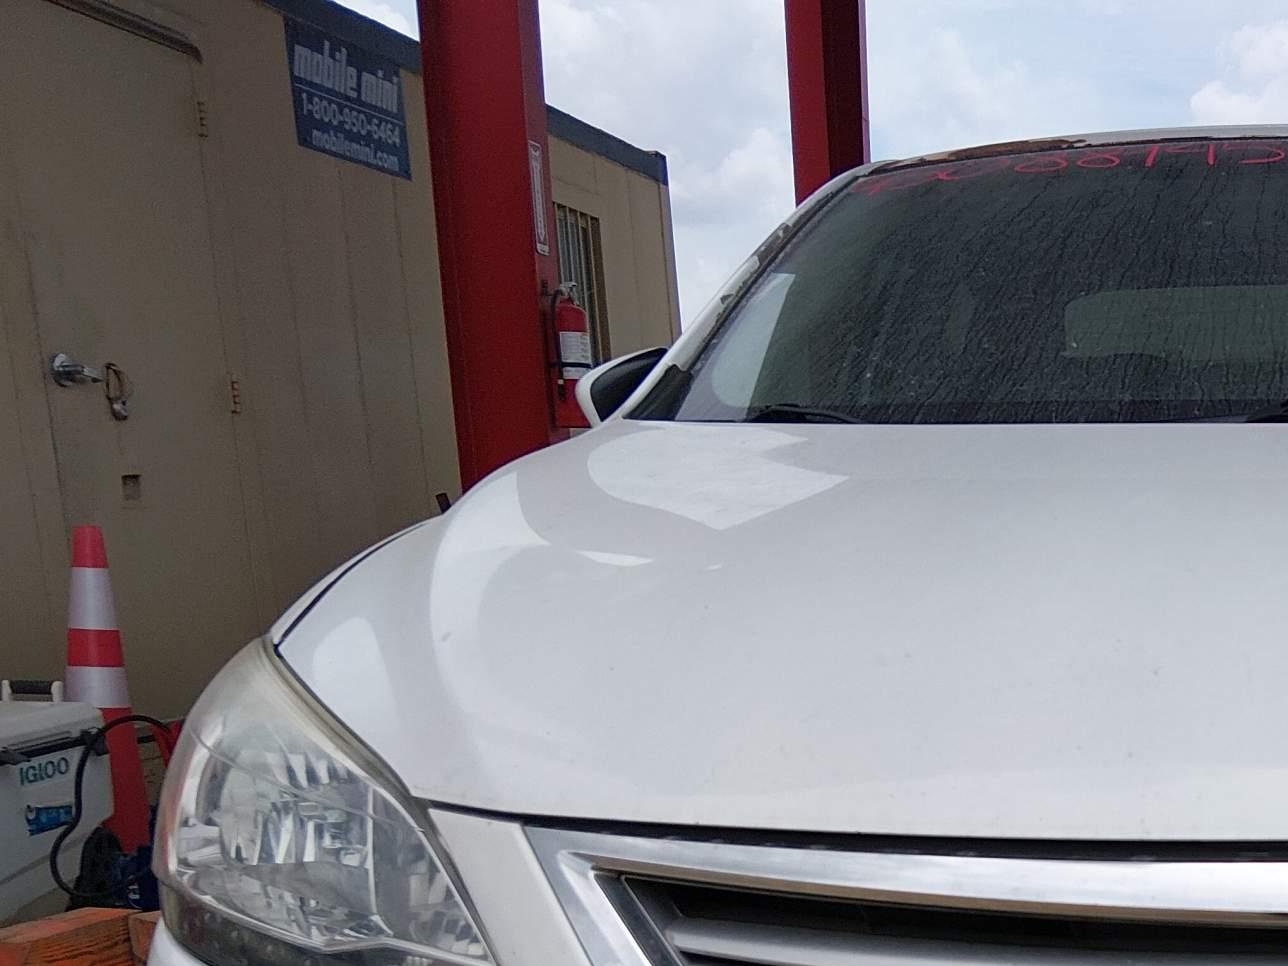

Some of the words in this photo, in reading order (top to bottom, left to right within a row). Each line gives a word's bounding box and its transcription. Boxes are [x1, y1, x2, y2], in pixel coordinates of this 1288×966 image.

[294, 40, 358, 98] mobile
[361, 69, 399, 113] mini
[311, 129, 400, 171] mobilemini.com
[19, 756, 70, 786] IGLOO
